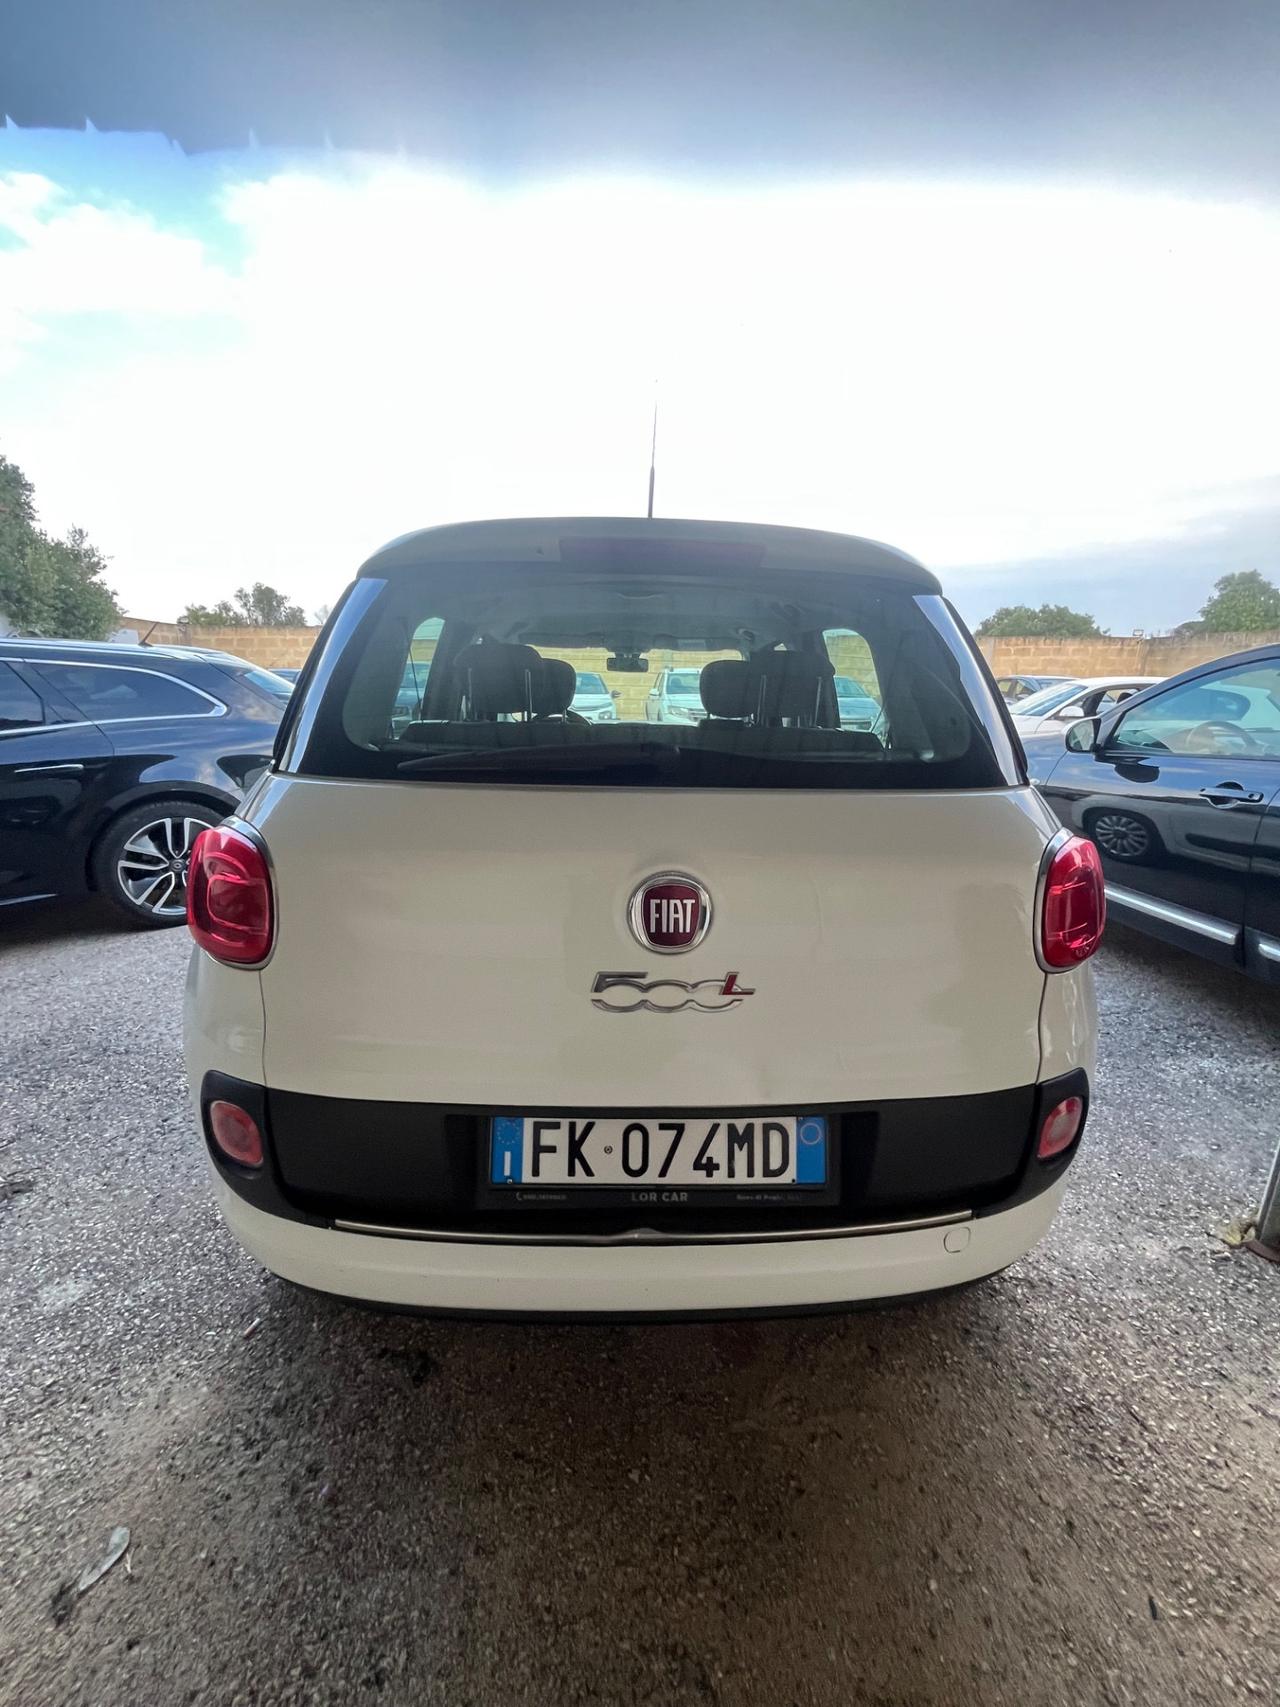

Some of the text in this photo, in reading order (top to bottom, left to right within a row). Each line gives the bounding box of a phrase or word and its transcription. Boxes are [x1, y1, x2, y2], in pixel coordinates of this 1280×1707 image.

[650, 898, 696, 933] FIAT
[590, 971, 756, 1013] 500L
[531, 1121, 790, 1179] FK 074MD
[631, 1191, 688, 1203] LOR CAR
